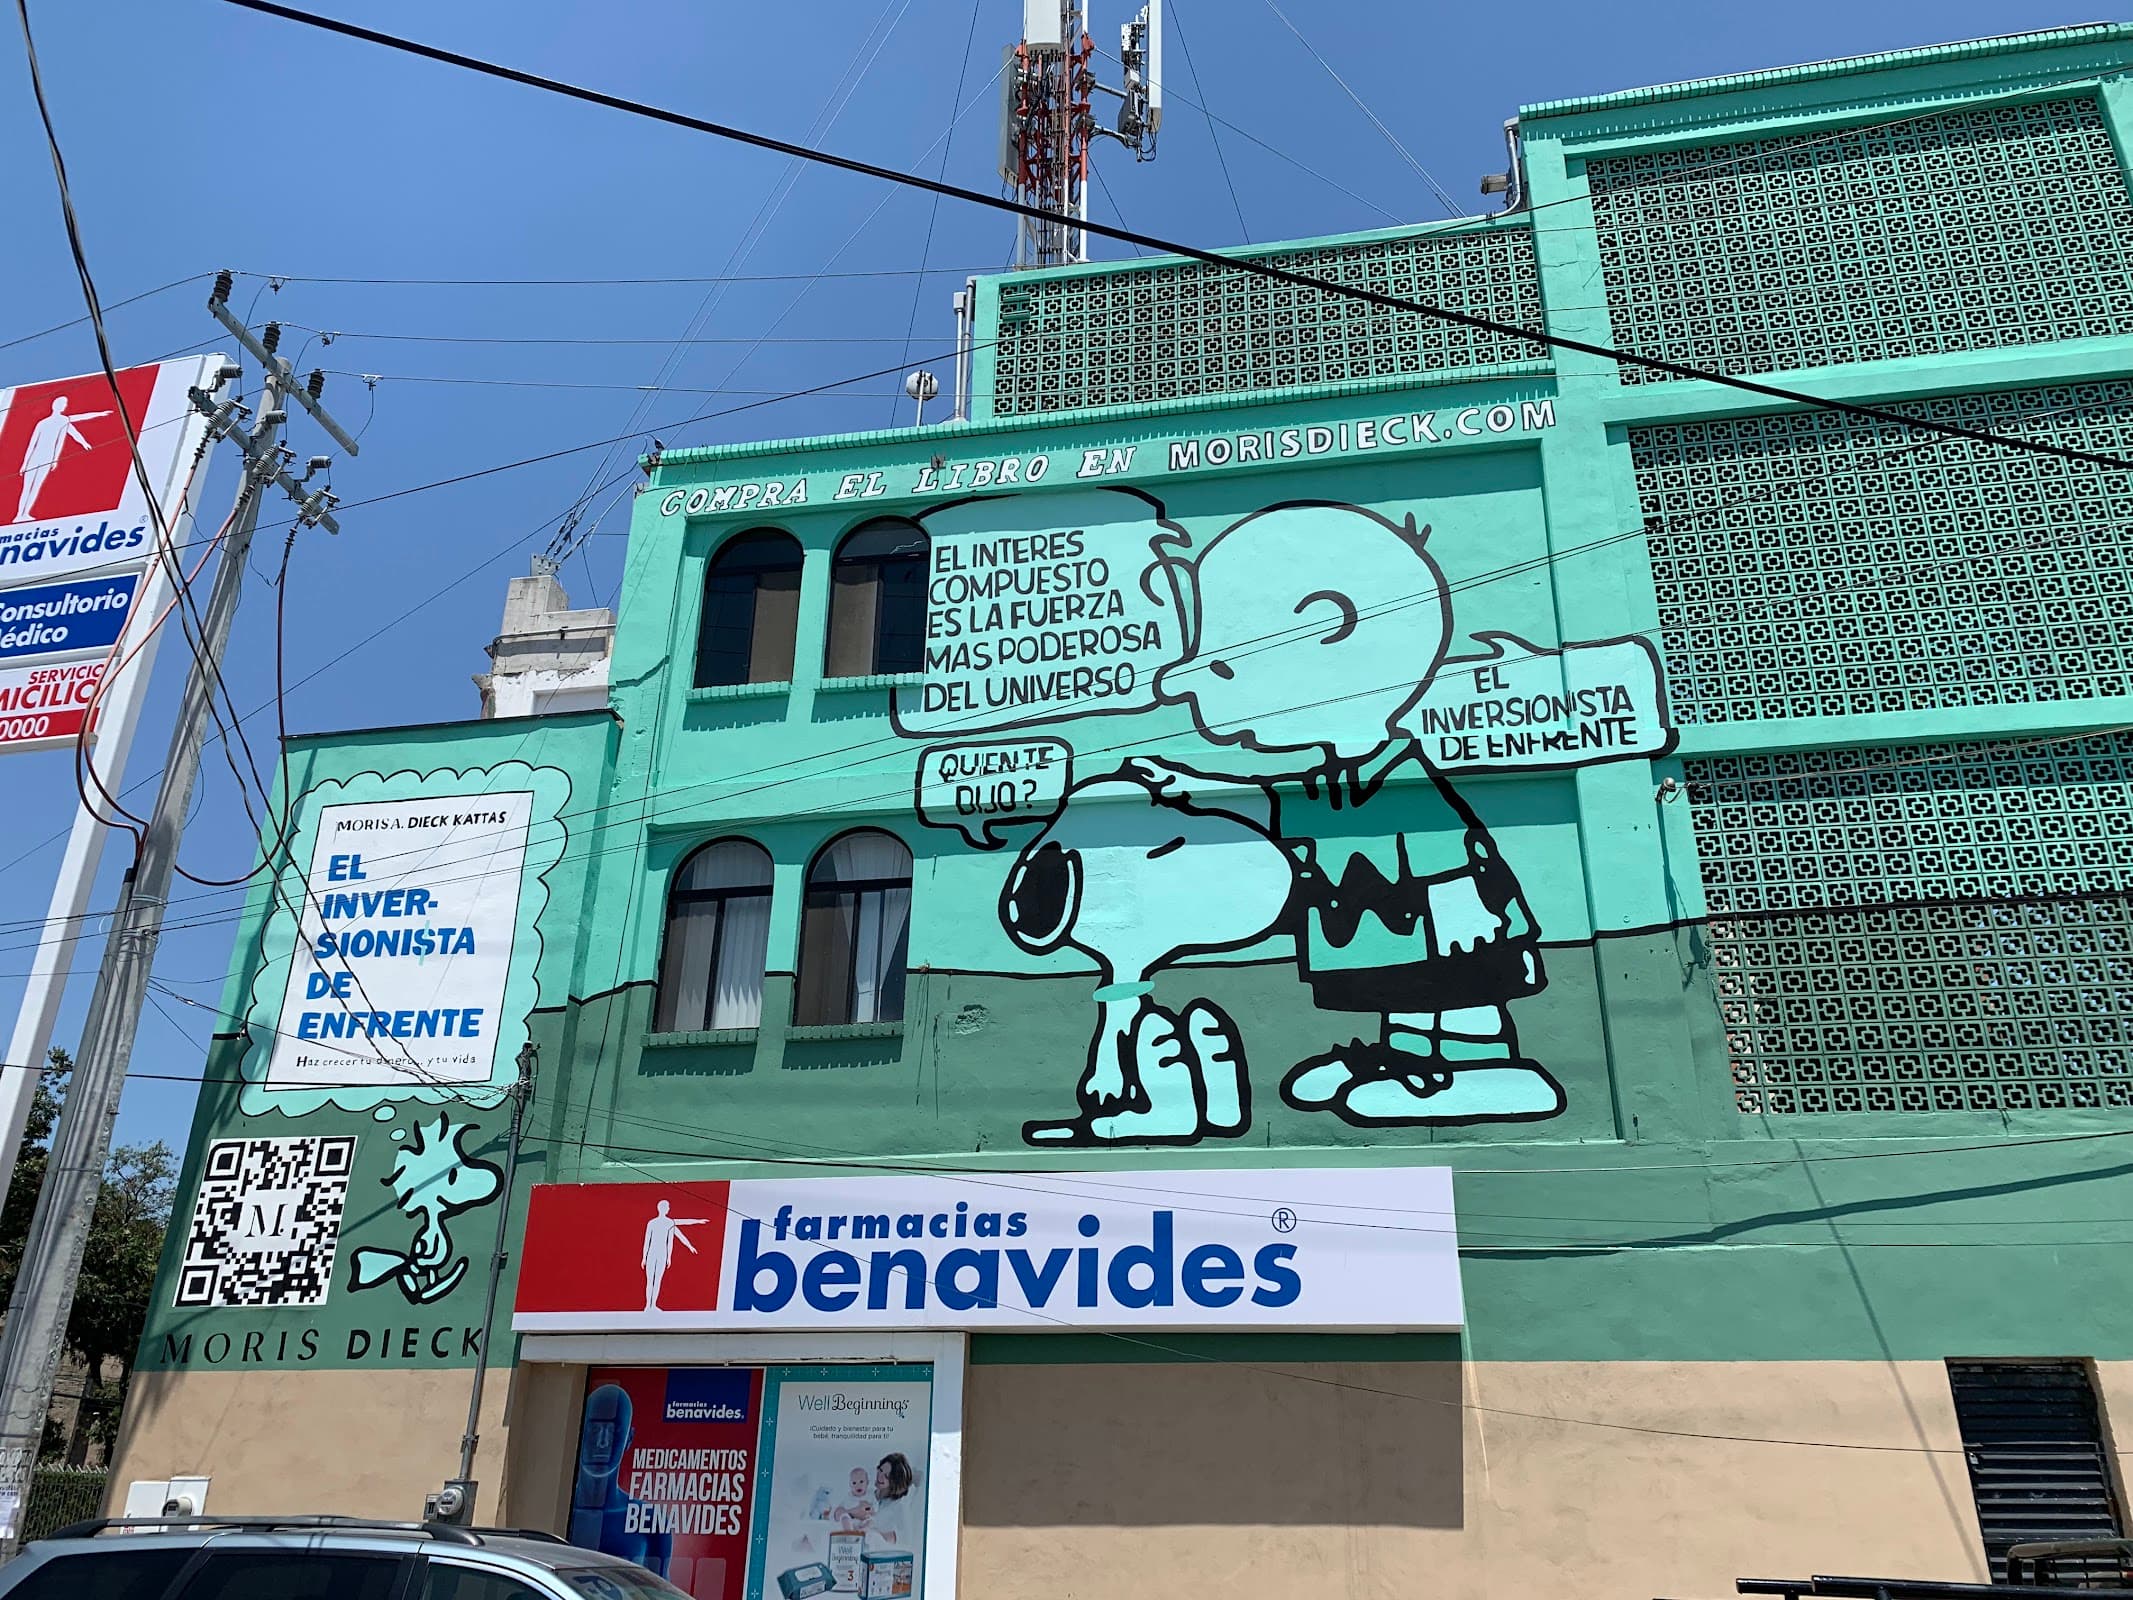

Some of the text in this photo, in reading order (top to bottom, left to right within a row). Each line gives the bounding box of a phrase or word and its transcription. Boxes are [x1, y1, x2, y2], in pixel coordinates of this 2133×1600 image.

[659, 400, 1556, 517] COMPRA EL LIBRO EN MORISDIECK.COM
[935, 530, 1084, 573] EL INTERES
[929, 557, 1109, 606] COMPUESTO
[0, 588, 128, 622] onsultorio
[927, 589, 1124, 638] ES LA FUERZA
[0, 623, 69, 648] édico
[925, 621, 1162, 675] MAS PODEROSA
[924, 662, 1135, 713] DEL UNIVERSO
[1473, 666, 1510, 693] EL
[1422, 685, 1635, 735] INVERSIONISTA
[1440, 735, 1480, 761] DE
[407, 815, 449, 829] DIECK
[452, 811, 507, 826] KATTAS
[327, 854, 367, 881] EL
[322, 888, 438, 919] INVER-
[306, 972, 353, 999] DE
[298, 1008, 484, 1039] ENFRENTE
[296, 1056, 319, 1067] Haz
[322, 1058, 357, 1067] crecer
[436, 1056, 448, 1064] tu
[452, 1053, 476, 1064] vida
[773, 1201, 1028, 1241] farmacias
[732, 1209, 1302, 1313] benavides
[159, 1326, 484, 1364] MORIS DIECK
[666, 1403, 742, 1419] benavides
[798, 1393, 910, 1419] Well Beginnings
[632, 1448, 747, 1471] MEDICAMENTOS
[628, 1472, 745, 1502] FARMACIAS
[624, 1503, 742, 1535] BENAVIDES
